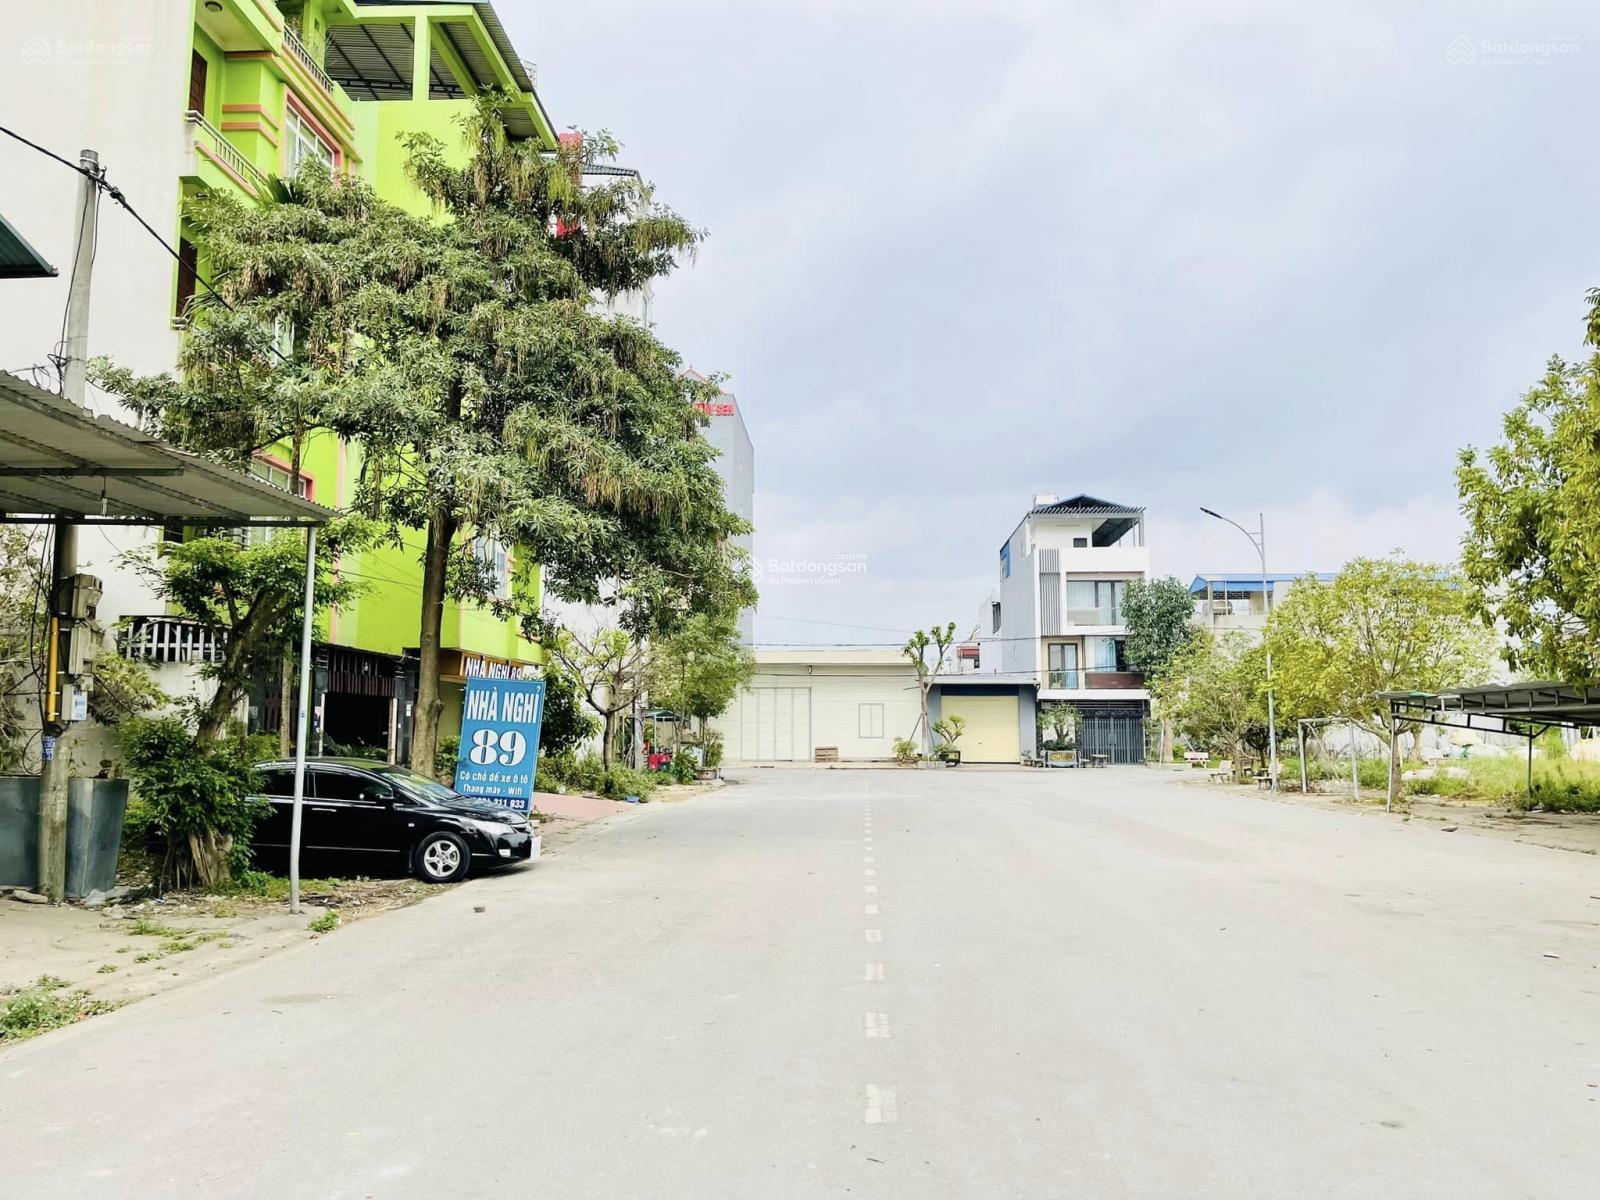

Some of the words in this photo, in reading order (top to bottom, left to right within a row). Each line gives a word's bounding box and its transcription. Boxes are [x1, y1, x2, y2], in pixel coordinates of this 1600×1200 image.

[465, 656, 486, 678] NHÀ
[467, 686, 498, 721] NHÀ
[502, 685, 541, 724] NGHỈ
[469, 728, 527, 767] 89
[459, 770, 471, 780] Có
[501, 774, 511, 783] xe
[520, 774, 528, 784] tô
[463, 783, 484, 794] Thang
